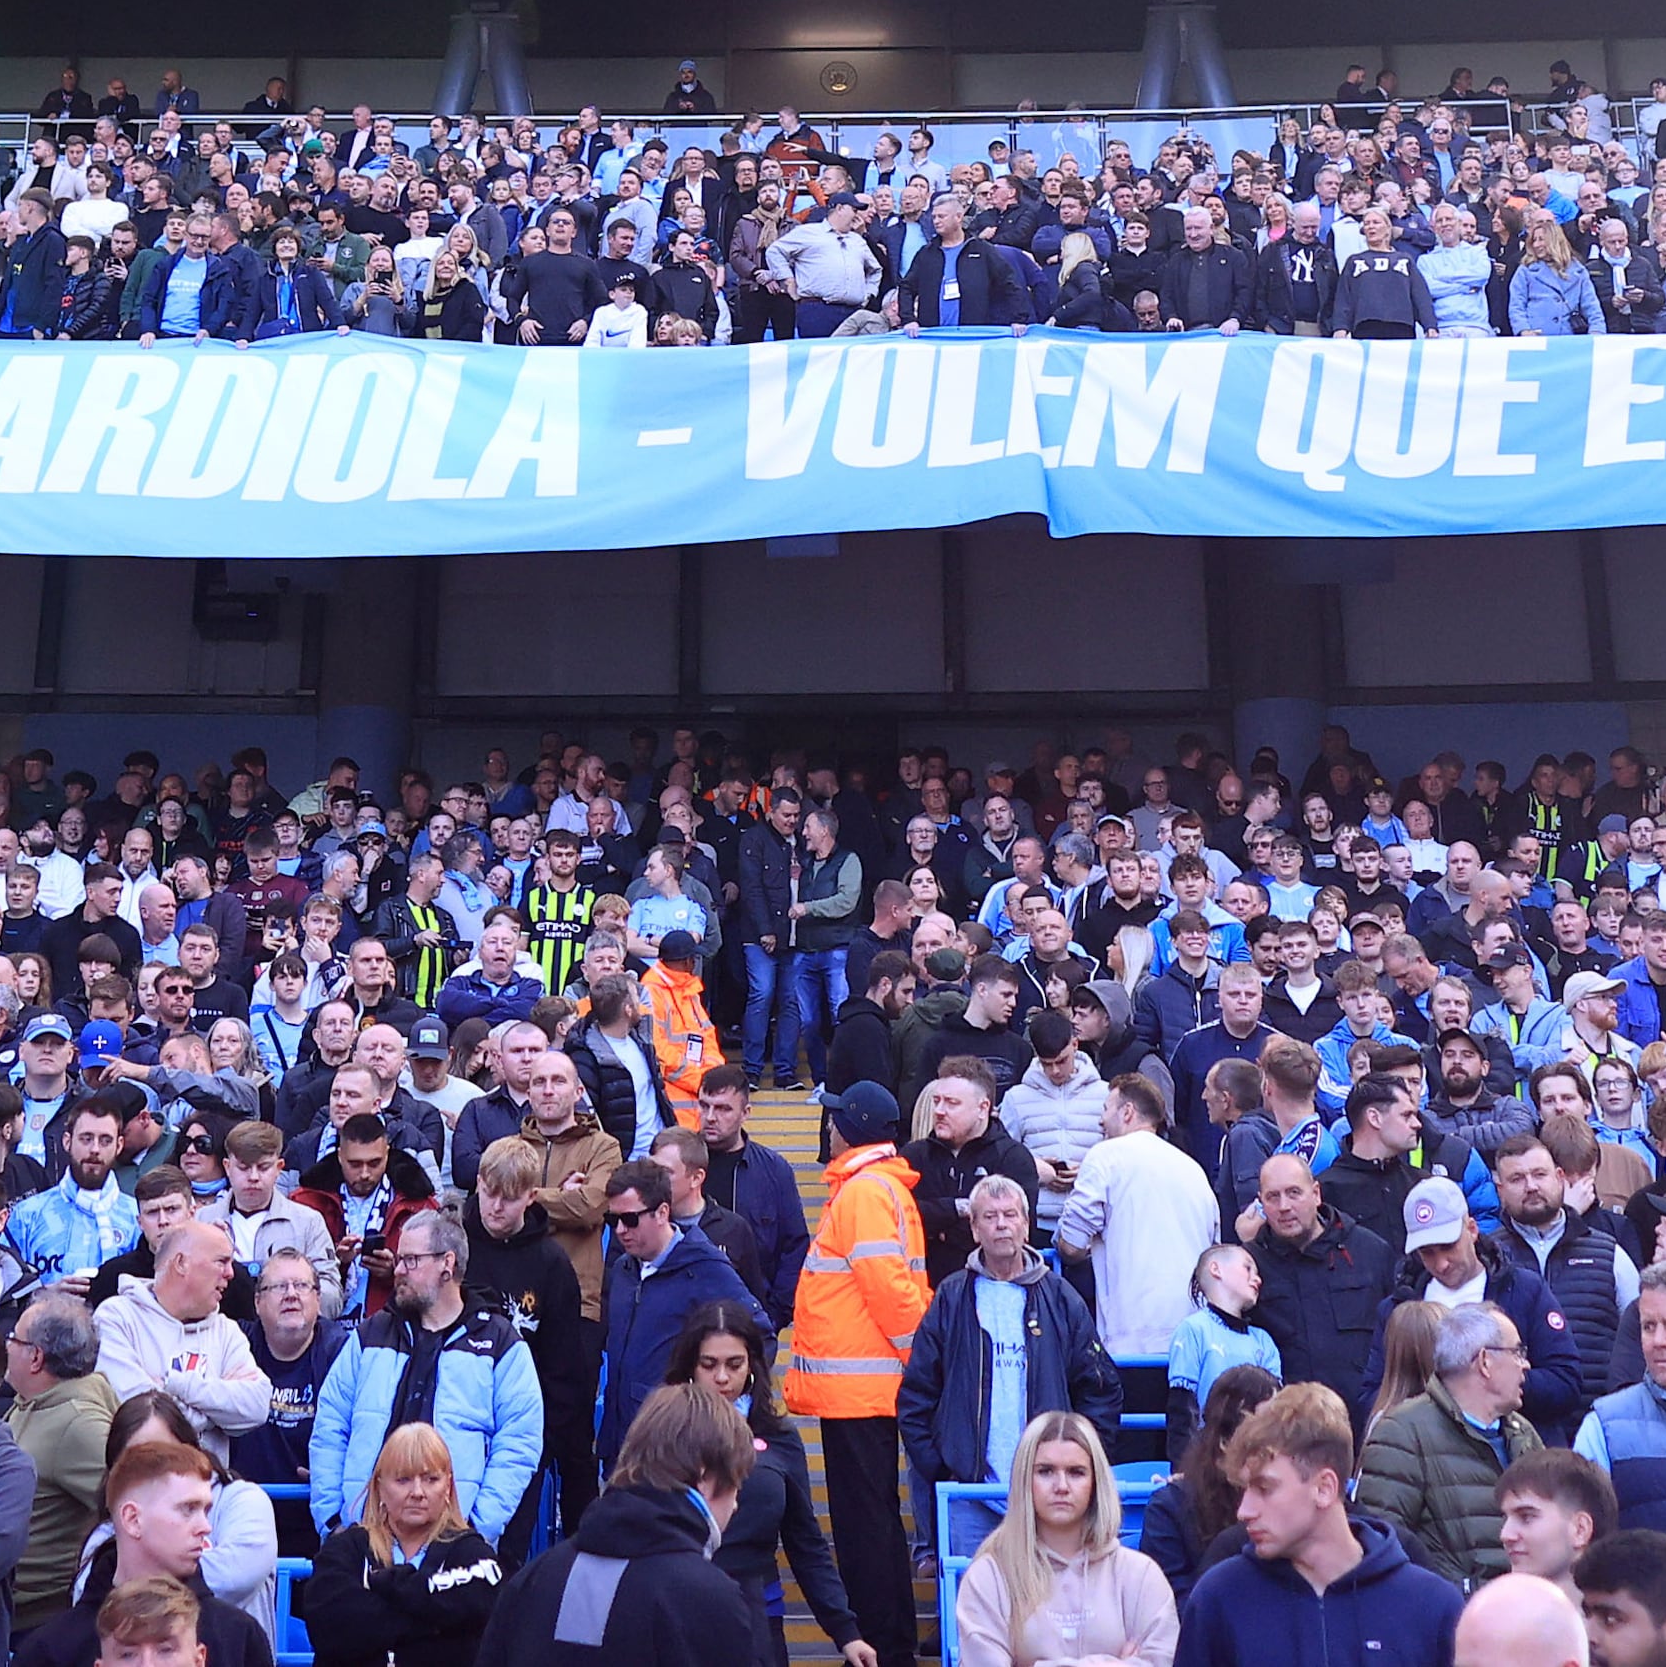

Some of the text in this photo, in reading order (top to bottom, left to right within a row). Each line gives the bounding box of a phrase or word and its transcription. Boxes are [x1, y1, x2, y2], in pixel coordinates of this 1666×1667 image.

[744, 340, 1228, 481] VOLEM
[1256, 337, 1564, 492] QUE
[535, 921, 581, 933] ETIHAD
